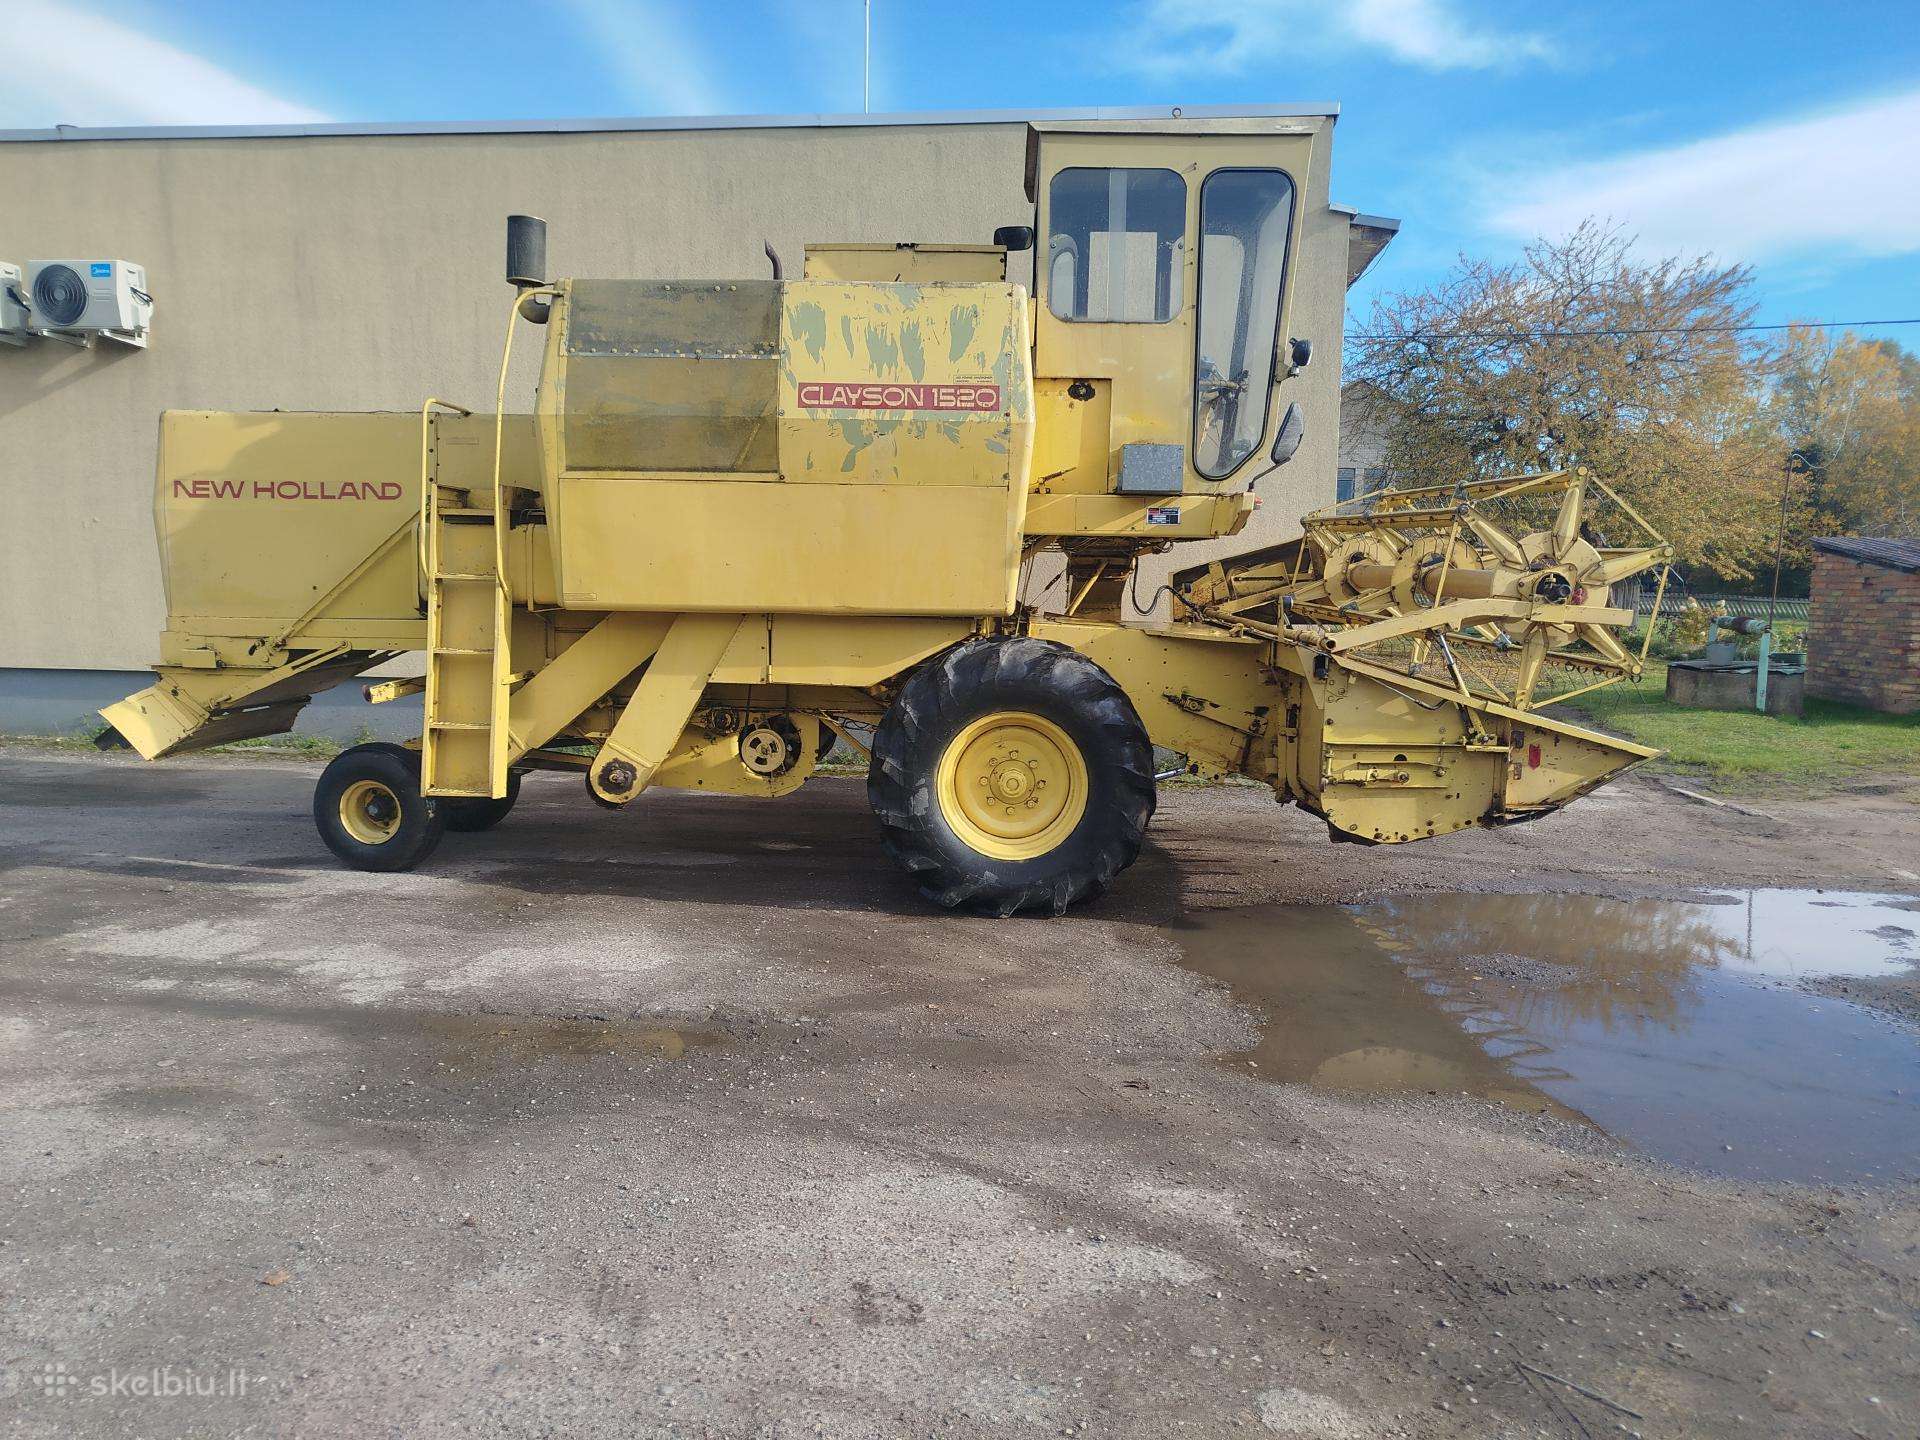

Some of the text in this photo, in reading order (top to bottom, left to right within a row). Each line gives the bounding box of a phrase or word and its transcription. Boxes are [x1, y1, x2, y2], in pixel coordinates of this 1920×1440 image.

[800, 386, 997, 408] CLAYSON 1520
[173, 480, 403, 500] NEW HOLLAND
